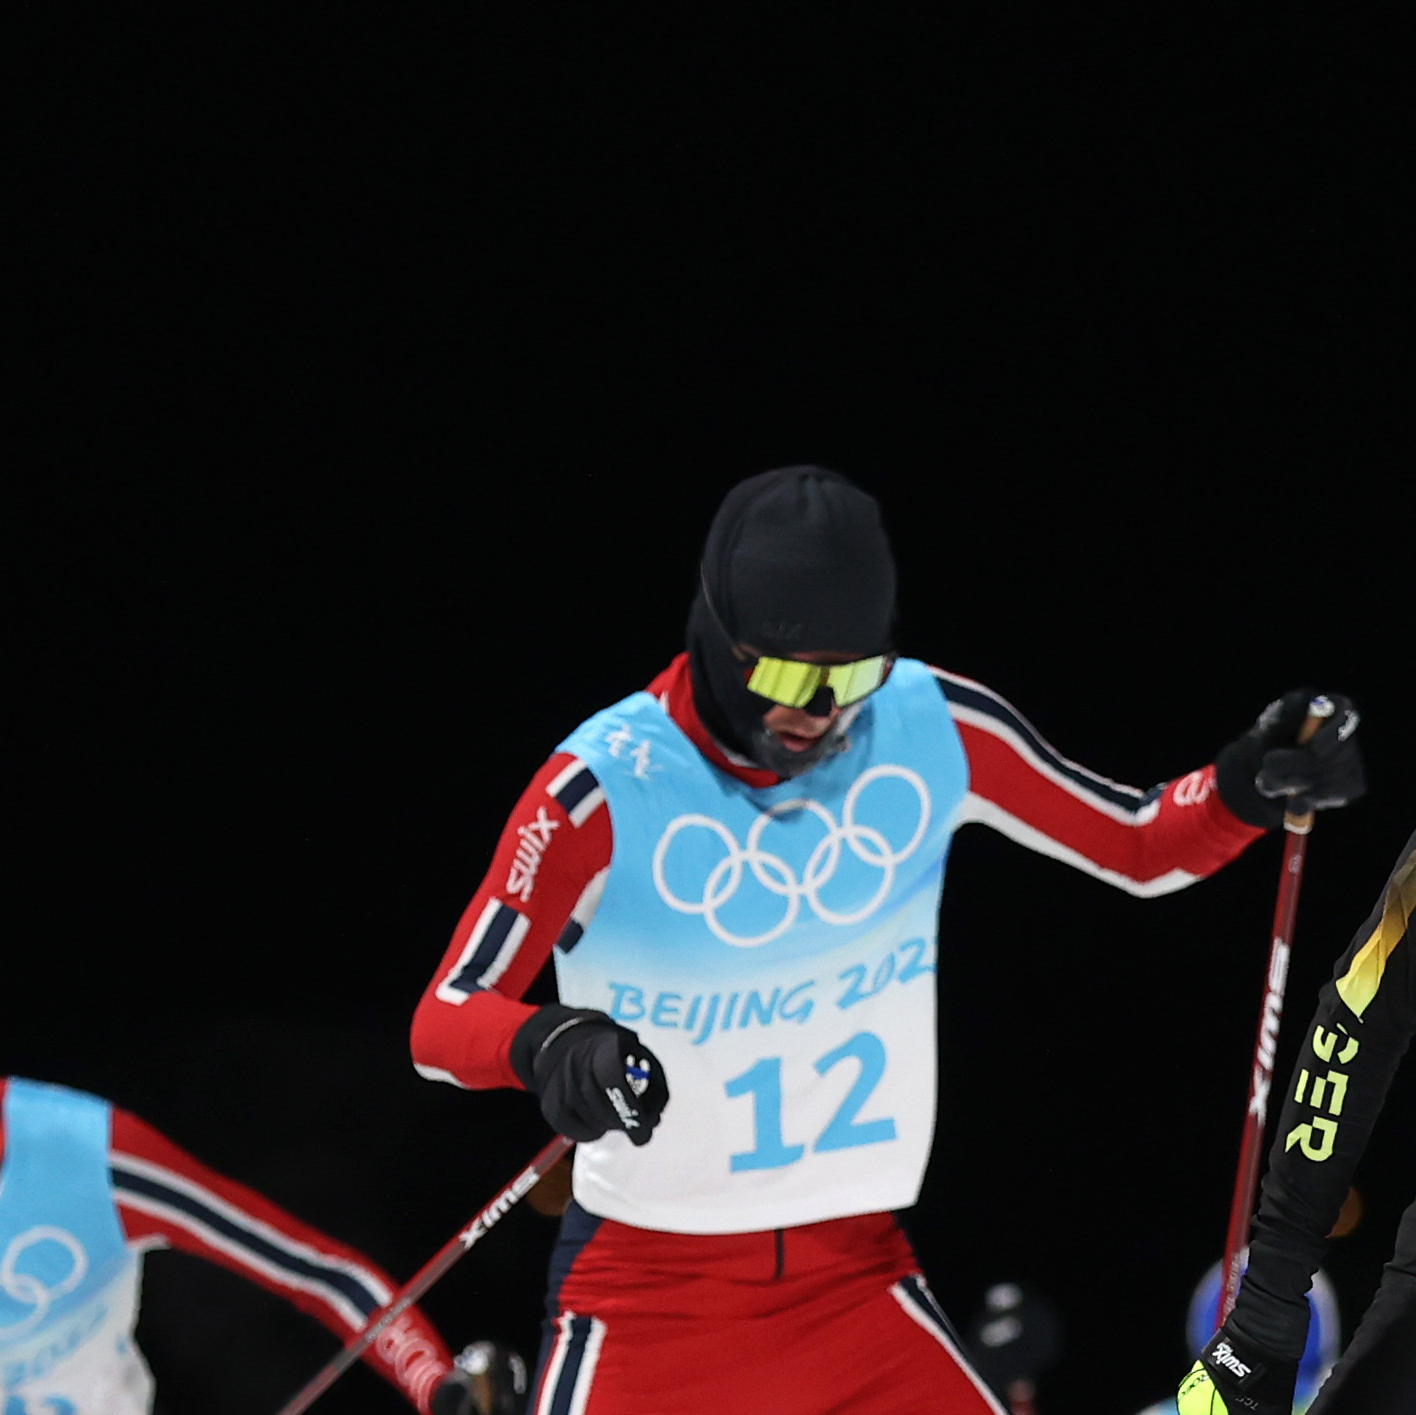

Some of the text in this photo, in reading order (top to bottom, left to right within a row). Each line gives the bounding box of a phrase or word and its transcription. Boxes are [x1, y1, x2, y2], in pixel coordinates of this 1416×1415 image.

[606, 935, 937, 1045] BEIJING 202
[723, 1030, 898, 1175] 12
[1284, 1022, 1360, 1163] GER
